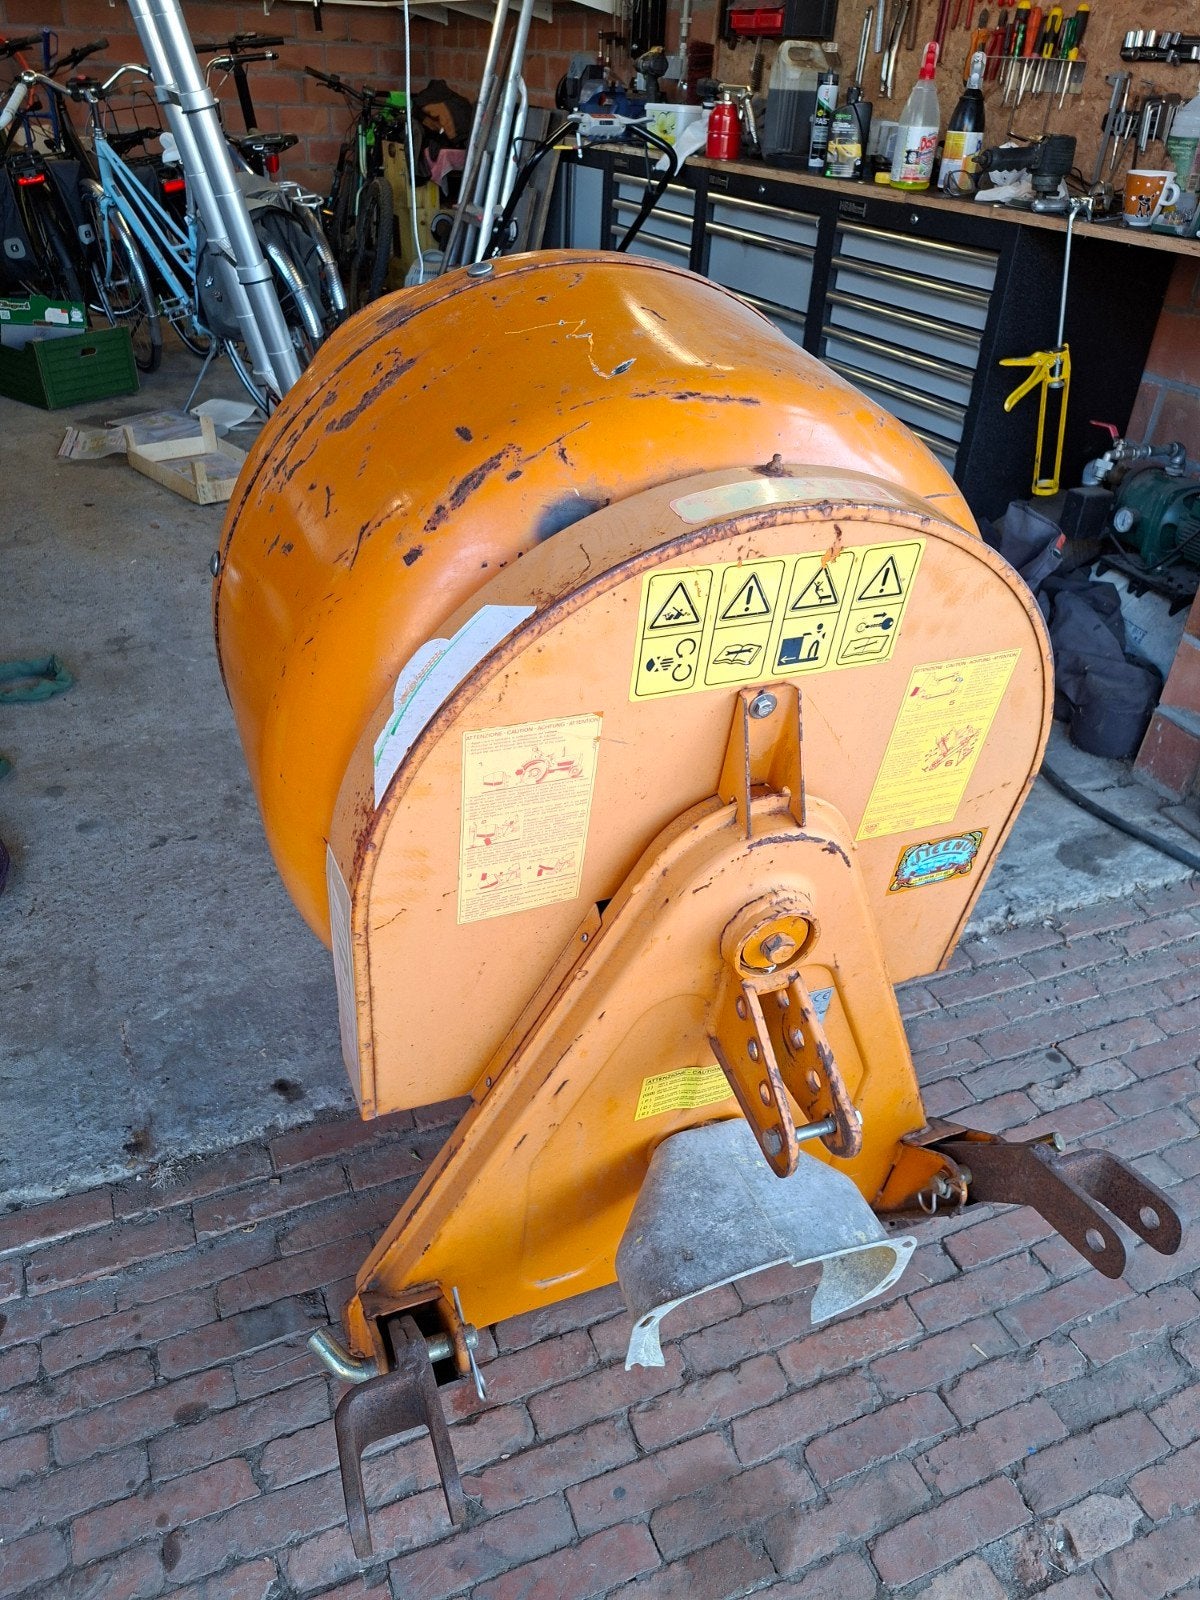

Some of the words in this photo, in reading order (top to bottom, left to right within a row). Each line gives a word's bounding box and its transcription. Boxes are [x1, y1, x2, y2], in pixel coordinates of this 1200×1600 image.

[465, 731, 502, 741] ATTENZIONE
[506, 727, 533, 738] CAUTION
[537, 721, 566, 732] ACHTUNG
[568, 716, 599, 727] ATTENTION
[646, 1070, 686, 1085] ATTENZIONE
